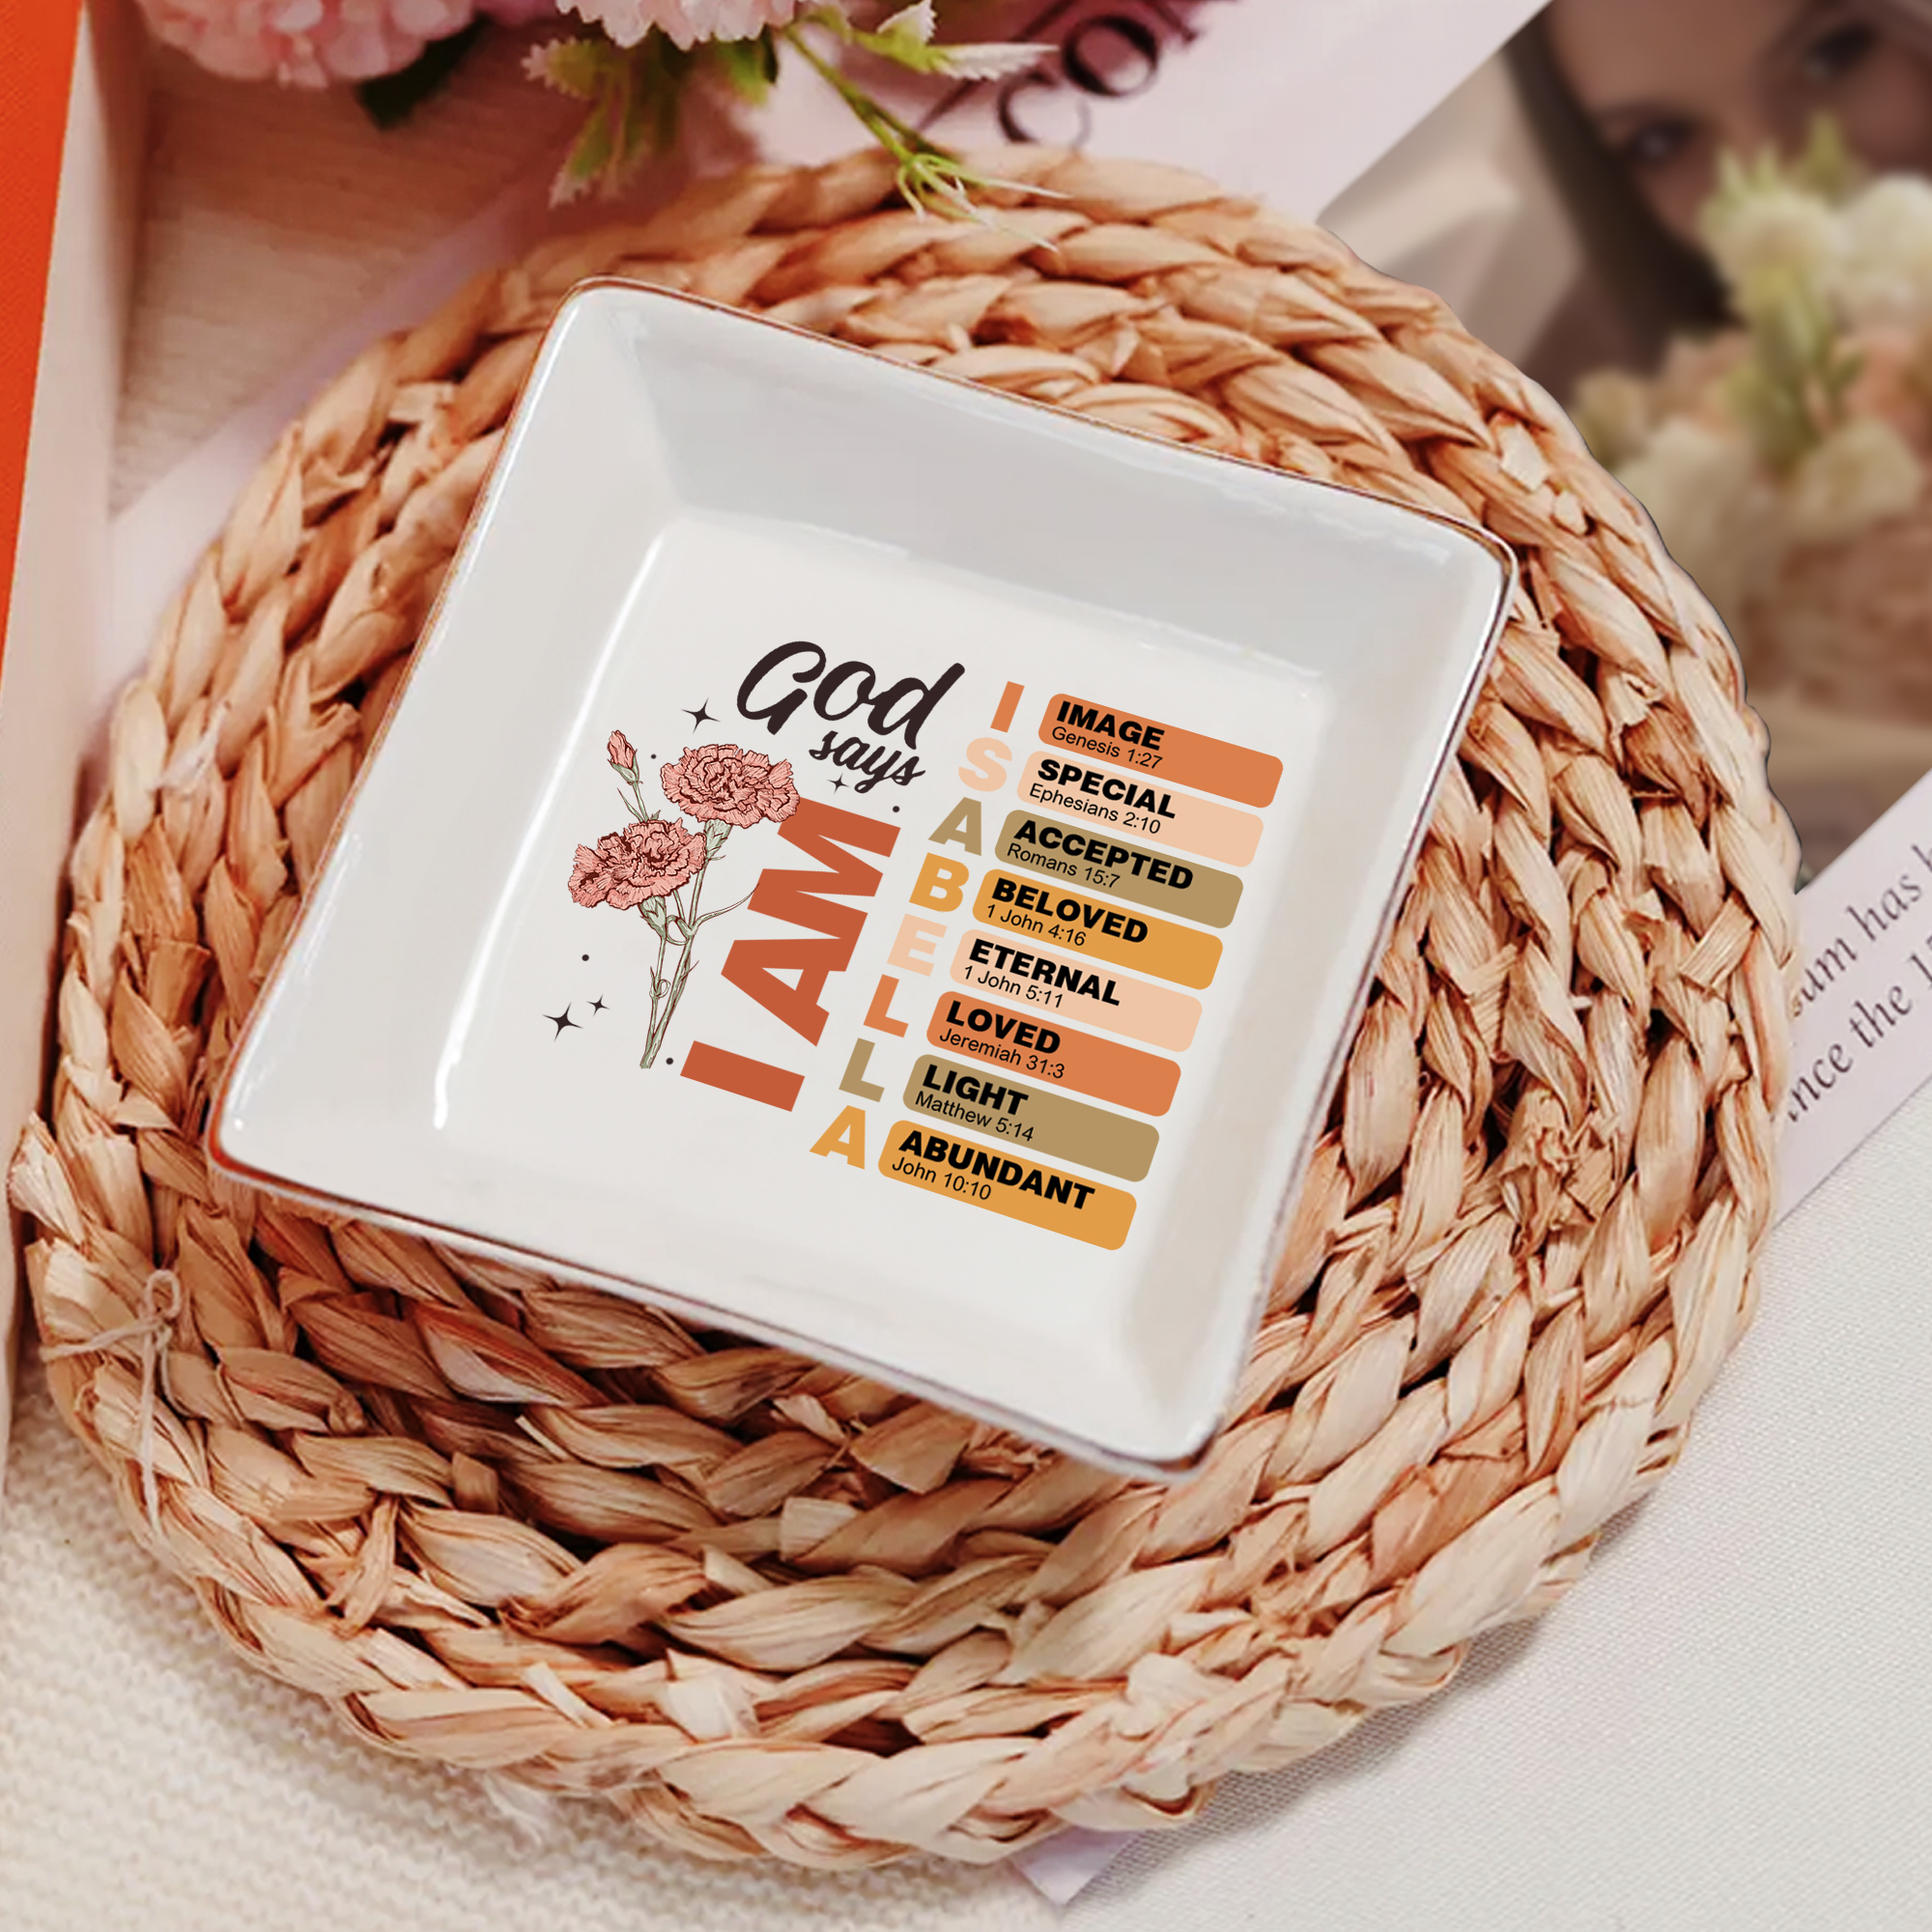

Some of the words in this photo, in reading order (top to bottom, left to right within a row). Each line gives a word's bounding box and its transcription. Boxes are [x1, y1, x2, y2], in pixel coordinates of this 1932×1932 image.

[737, 640, 966, 750] God
[1051, 725, 1121, 757] Genesis
[1127, 749, 1163, 769] 1:27
[1056, 700, 1165, 751] IMAGE
[809, 731, 926, 794] says
[1037, 758, 1176, 819] SPECIAL
[1029, 782, 1119, 822] Ephesians
[1122, 811, 1161, 834] 2:10
[1007, 842, 1078, 876] Romans
[1085, 867, 1121, 888] 15:7
[1013, 820, 1194, 890] ACCEPTED
[721, 797, 901, 1047] AM
[986, 904, 995, 919] 1
[1000, 908, 1044, 934] John
[1048, 923, 1087, 947] 4:16
[991, 877, 1149, 943] BELOVED
[1846, 874, 1922, 942] has
[964, 965, 972, 980] 1
[978, 969, 1021, 995] John
[1025, 985, 1063, 1008] 5:11
[969, 938, 1121, 1006] ETERNAL
[946, 1000, 1061, 1054] LOVED
[1850, 984, 1913, 1048] the
[680, 1040, 806, 1113] I
[940, 1028, 1021, 1065] Jeremiah
[1026, 1055, 1065, 1079] 31:3
[915, 1091, 992, 1127] Matthew
[995, 1117, 1035, 1142] 5:14
[923, 1064, 1029, 1116] LIGHT
[892, 1156, 936, 1182] John
[944, 1174, 992, 1201] 10:10
[898, 1130, 1095, 1209] ABUNDANT
